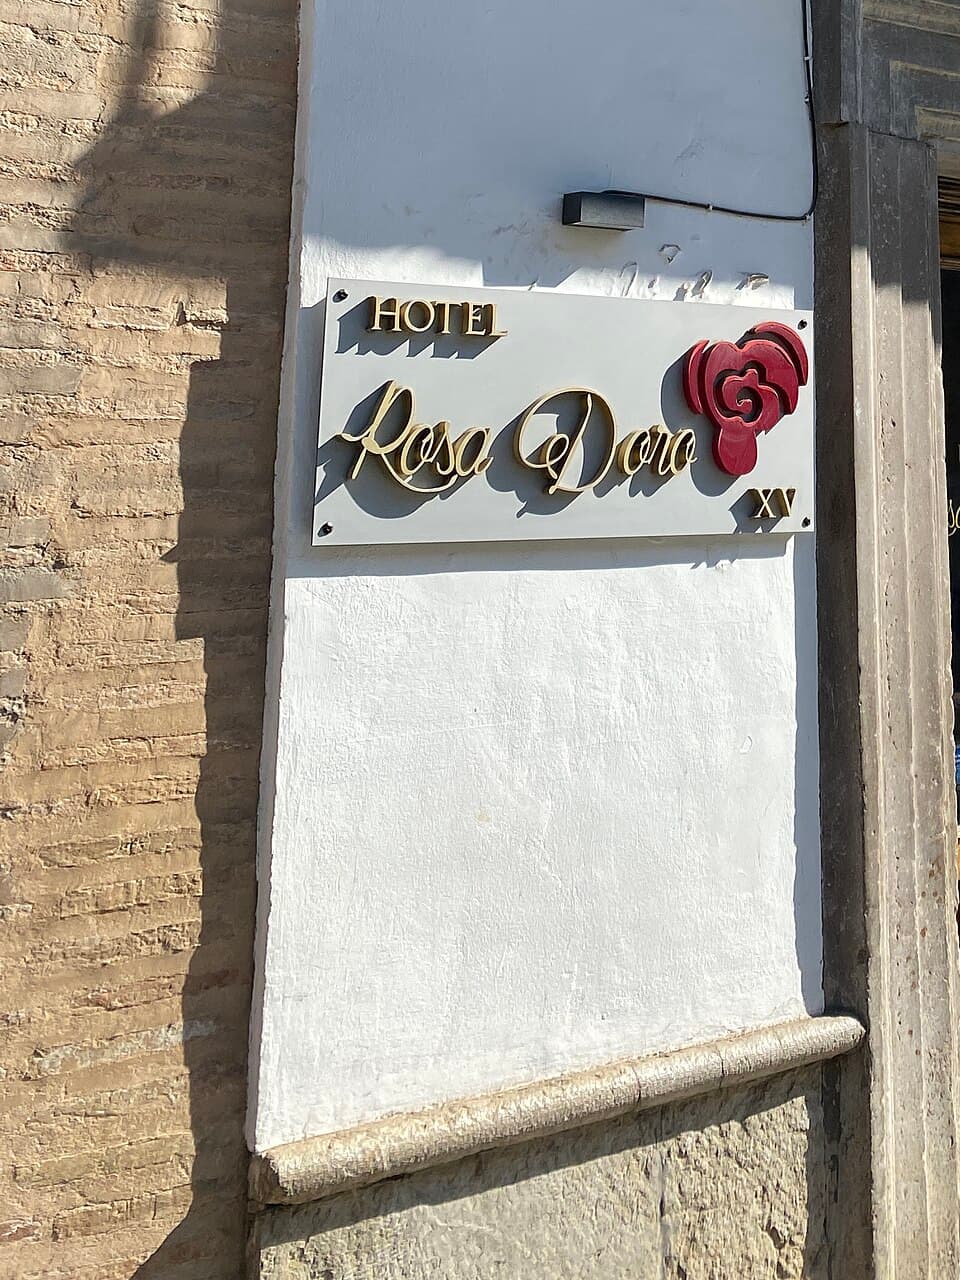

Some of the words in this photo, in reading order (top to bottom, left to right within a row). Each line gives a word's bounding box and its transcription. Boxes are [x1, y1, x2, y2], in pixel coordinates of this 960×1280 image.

[369, 296, 508, 337] HOTEL
[340, 379, 494, 494] Rosa
[750, 488, 796, 520] XV
